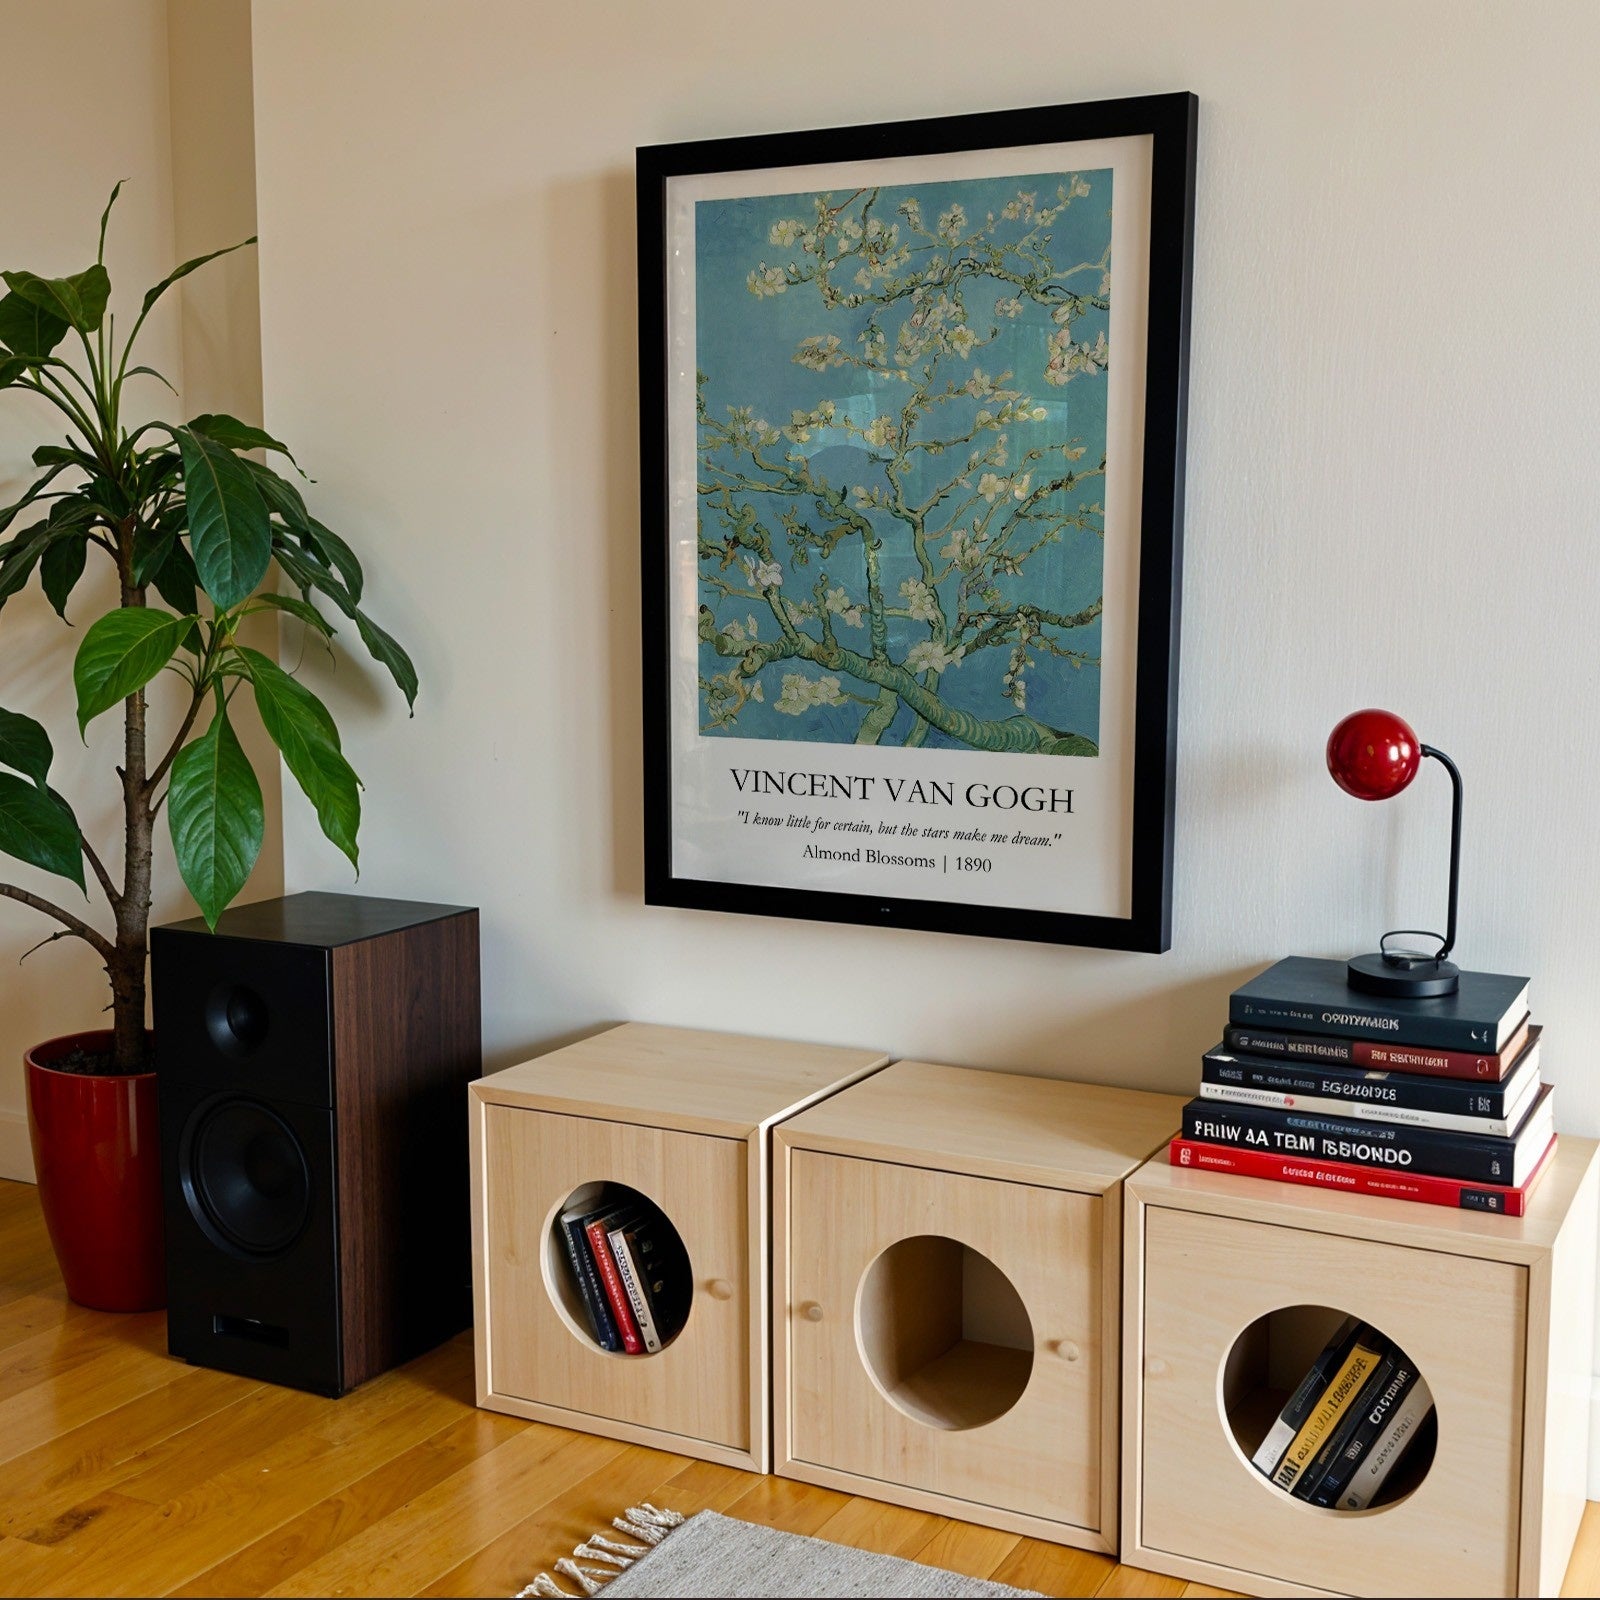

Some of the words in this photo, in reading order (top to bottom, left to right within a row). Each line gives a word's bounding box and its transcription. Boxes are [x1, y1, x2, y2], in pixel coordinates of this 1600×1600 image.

[730, 768, 876, 801] VINCENT
[882, 777, 956, 808] VAN
[964, 783, 1075, 815] GOGH
[752, 812, 784, 828] know
[786, 813, 812, 829] little
[812, 816, 832, 834] for
[832, 821, 874, 836] certain,
[877, 821, 899, 836] but
[900, 822, 919, 837] the
[920, 825, 950, 840] stars
[952, 828, 987, 843] make
[989, 833, 1009, 843] me
[1011, 832, 1063, 848] dream."
[802, 844, 861, 863] Almond
[865, 849, 936, 869] Blossoms
[955, 857, 993, 874] 1890
